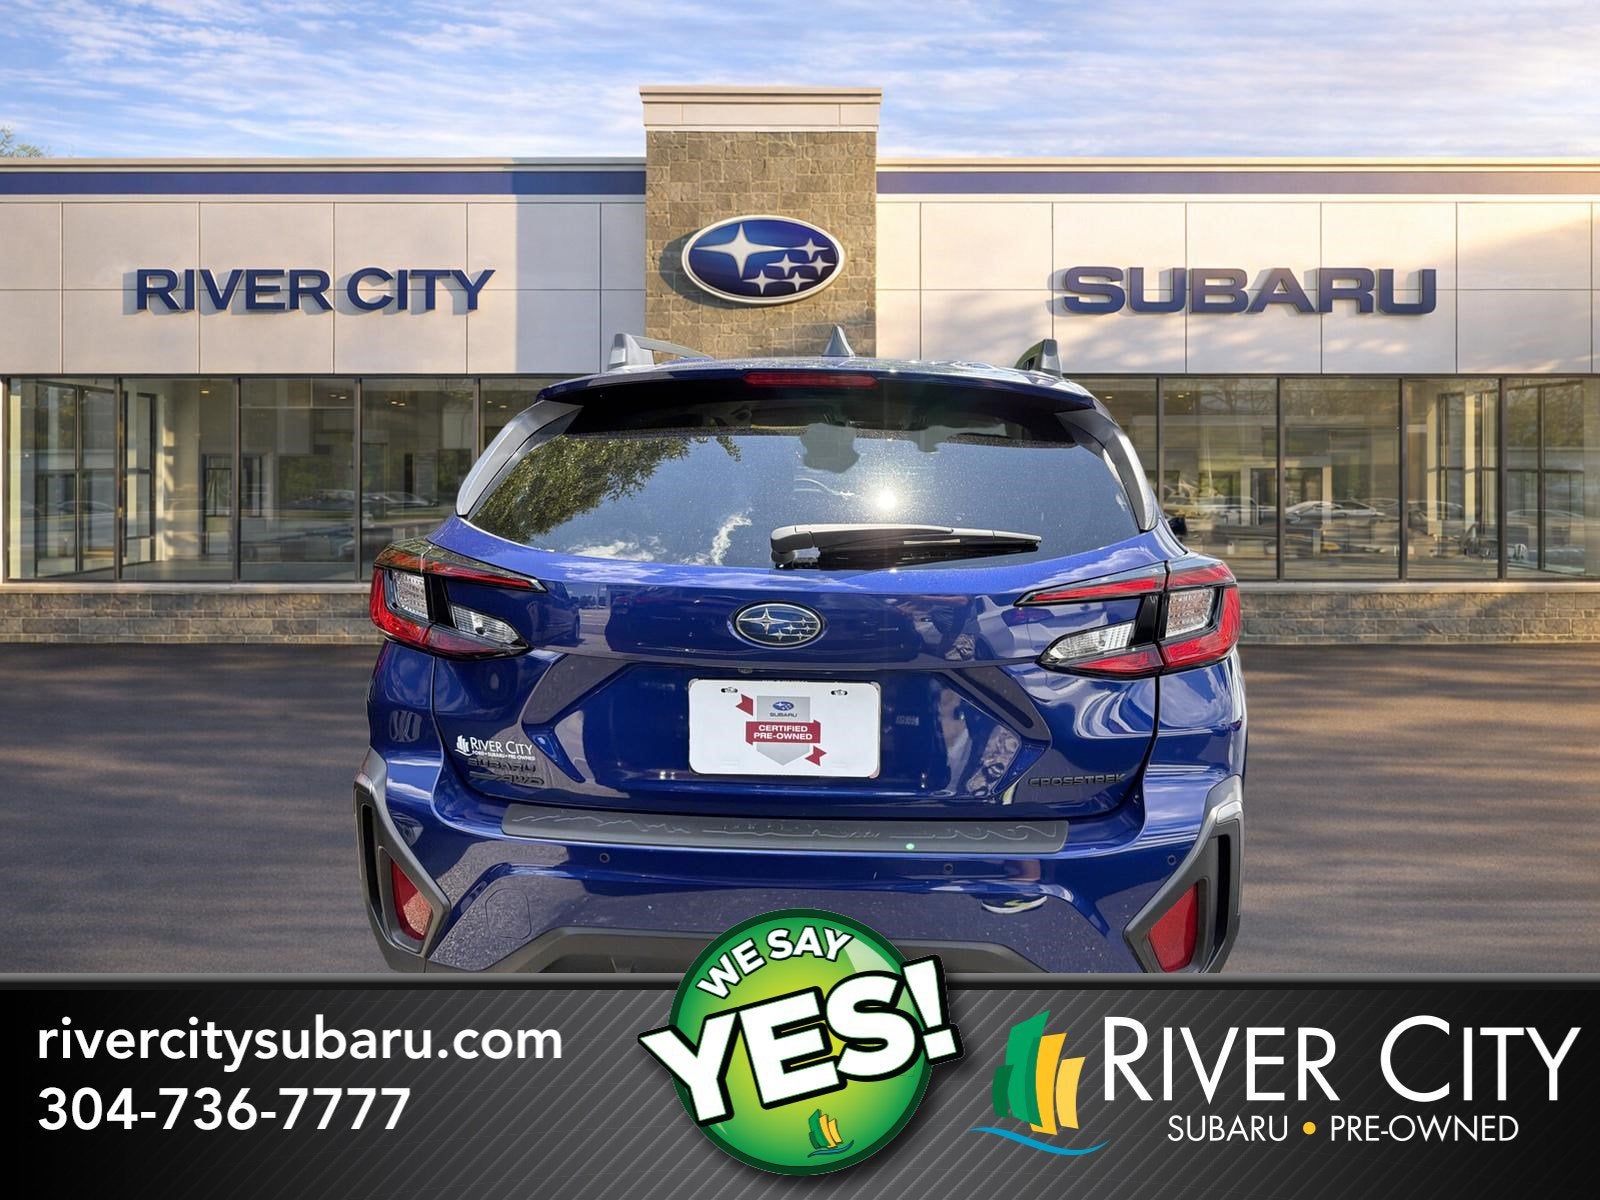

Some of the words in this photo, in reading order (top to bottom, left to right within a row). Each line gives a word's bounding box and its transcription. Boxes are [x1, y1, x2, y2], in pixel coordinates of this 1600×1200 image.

[135, 269, 334, 311] RIVER
[346, 267, 496, 310] CITY
[1062, 266, 1437, 315] SUBARU
[753, 732, 813, 740] PRE-OWNED
[758, 724, 808, 732] CERTIFIED
[470, 737, 503, 753] RIVER
[506, 741, 533, 755] CITY
[1028, 773, 1126, 787] CROSSTREK
